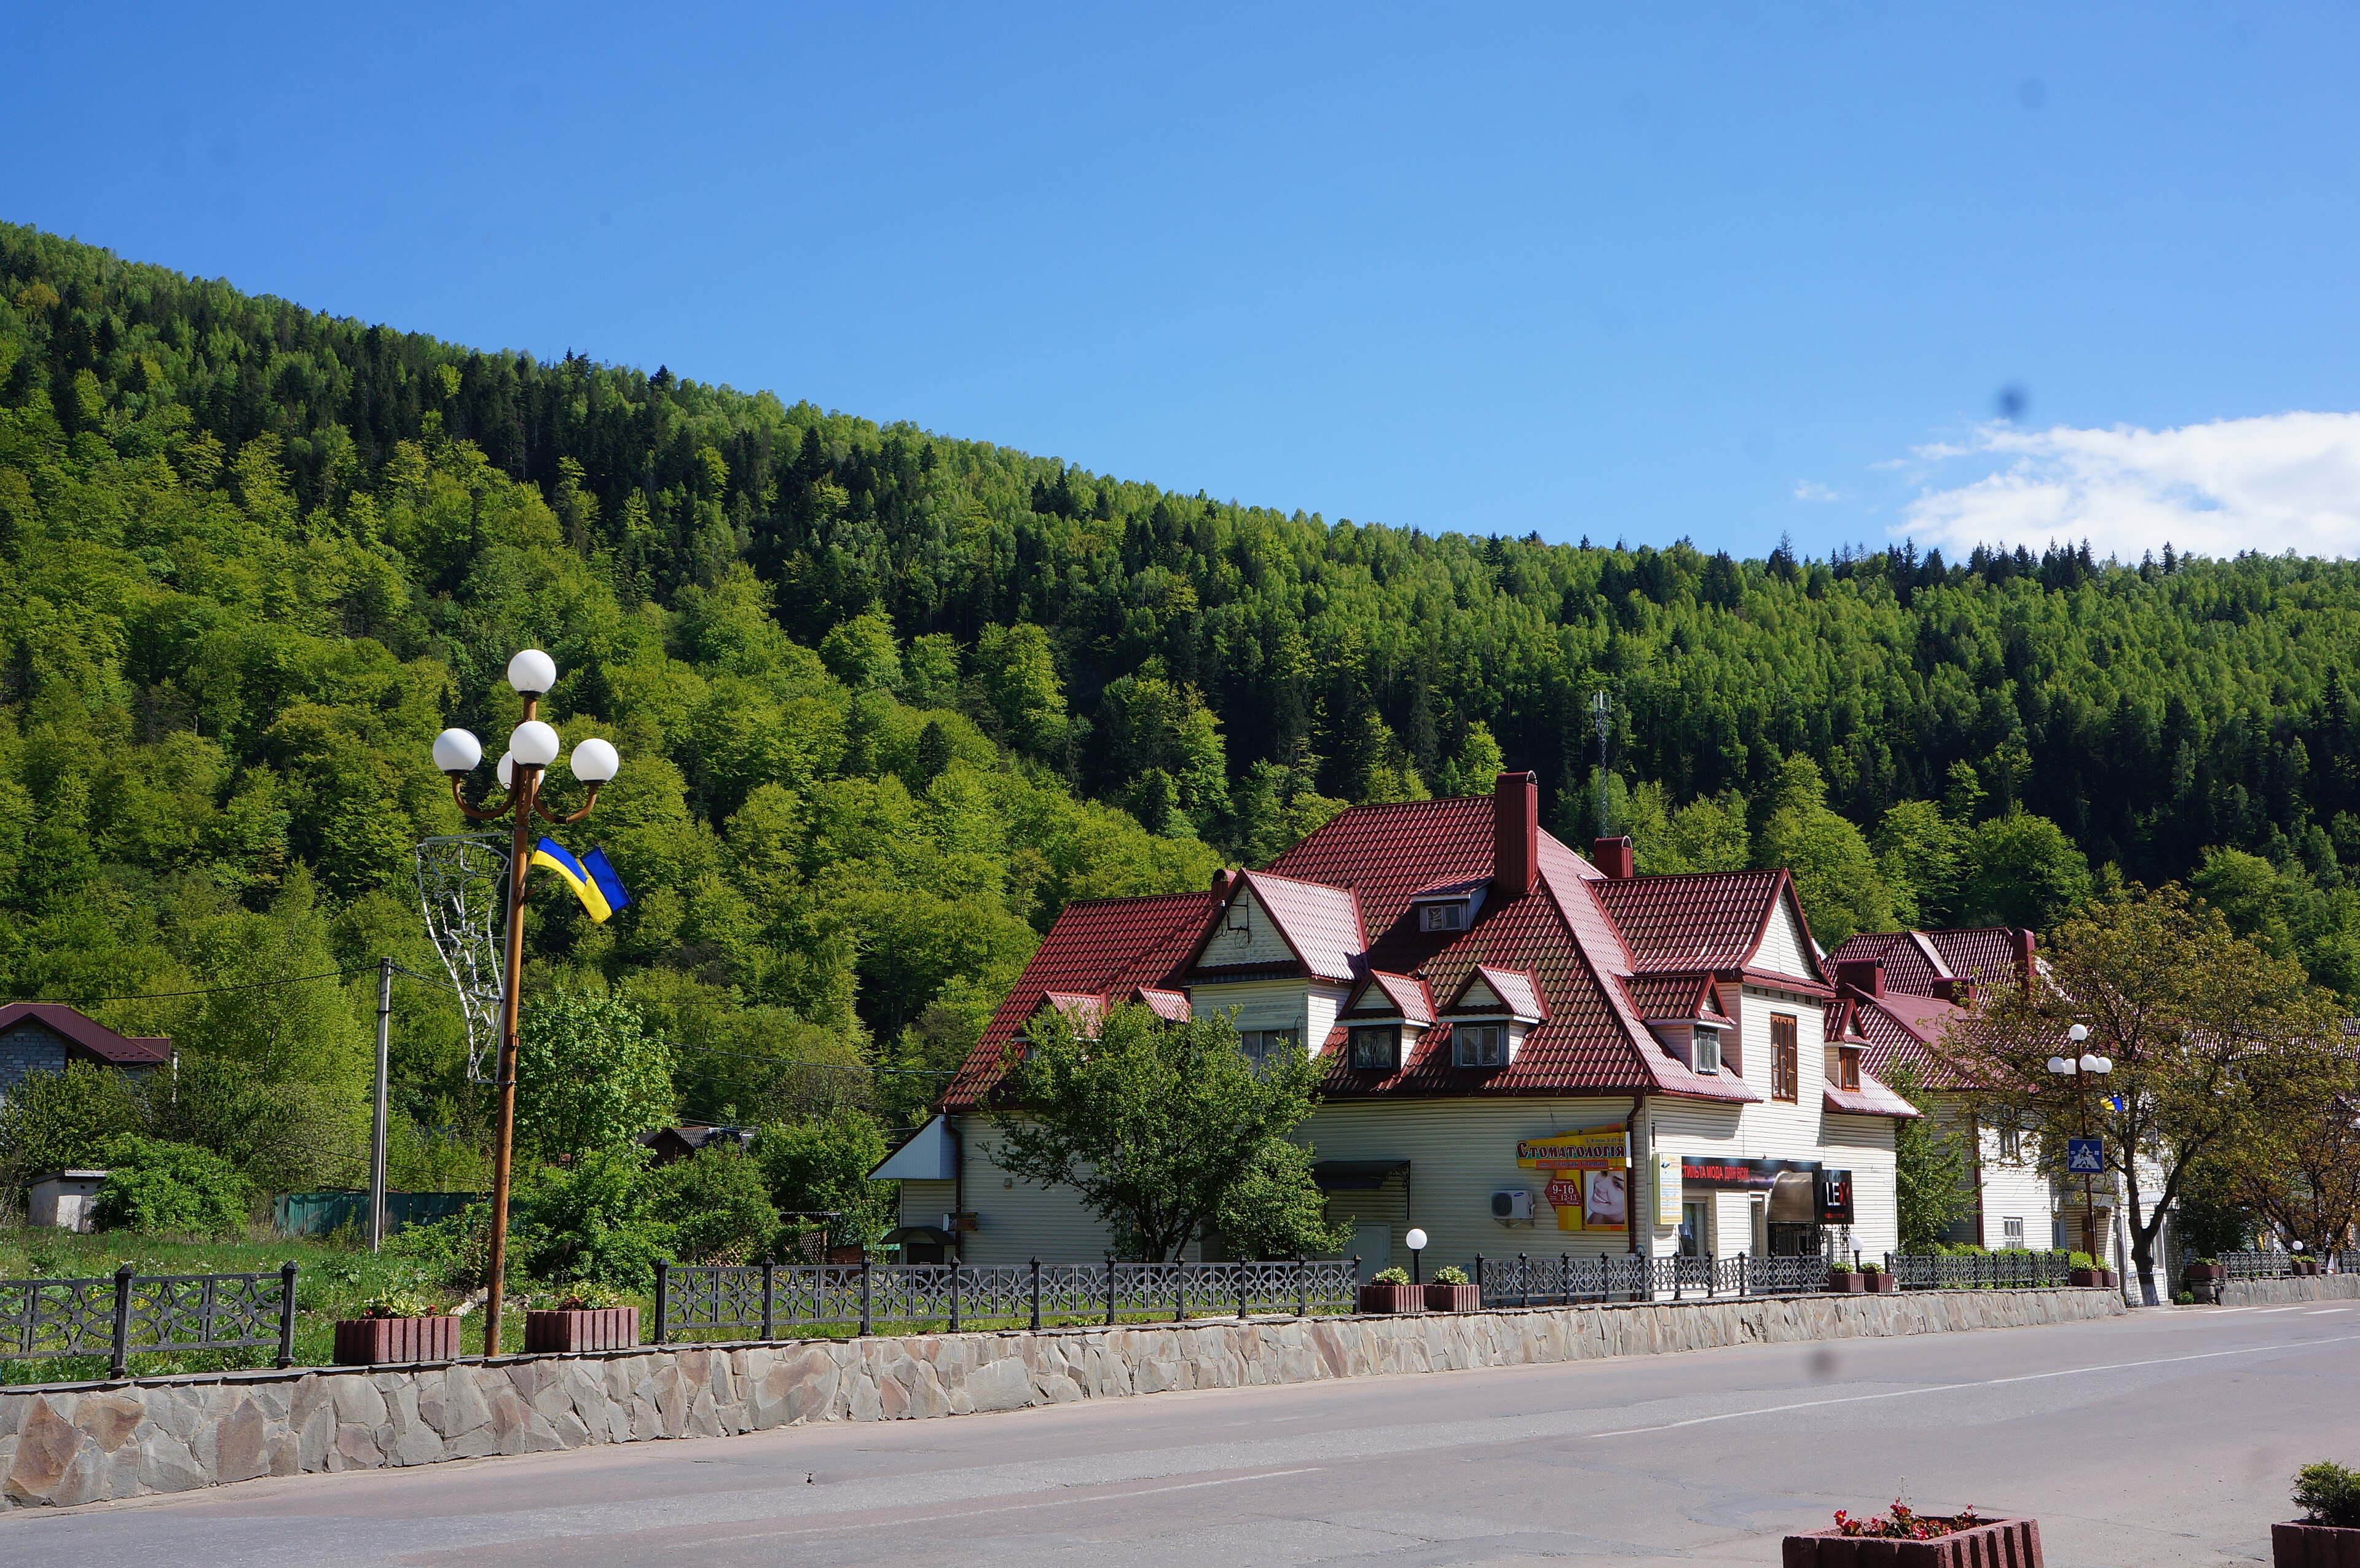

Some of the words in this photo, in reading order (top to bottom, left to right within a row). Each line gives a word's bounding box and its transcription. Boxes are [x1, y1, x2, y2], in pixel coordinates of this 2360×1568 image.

[1699, 1166, 1706, 1178] ТА
[1707, 1166, 1723, 1181] МОДА
[1725, 1167, 1736, 1181] ДЛЯ
[1552, 1185, 1574, 1194] 9-16
[1826, 1182, 1849, 1205] LEX
